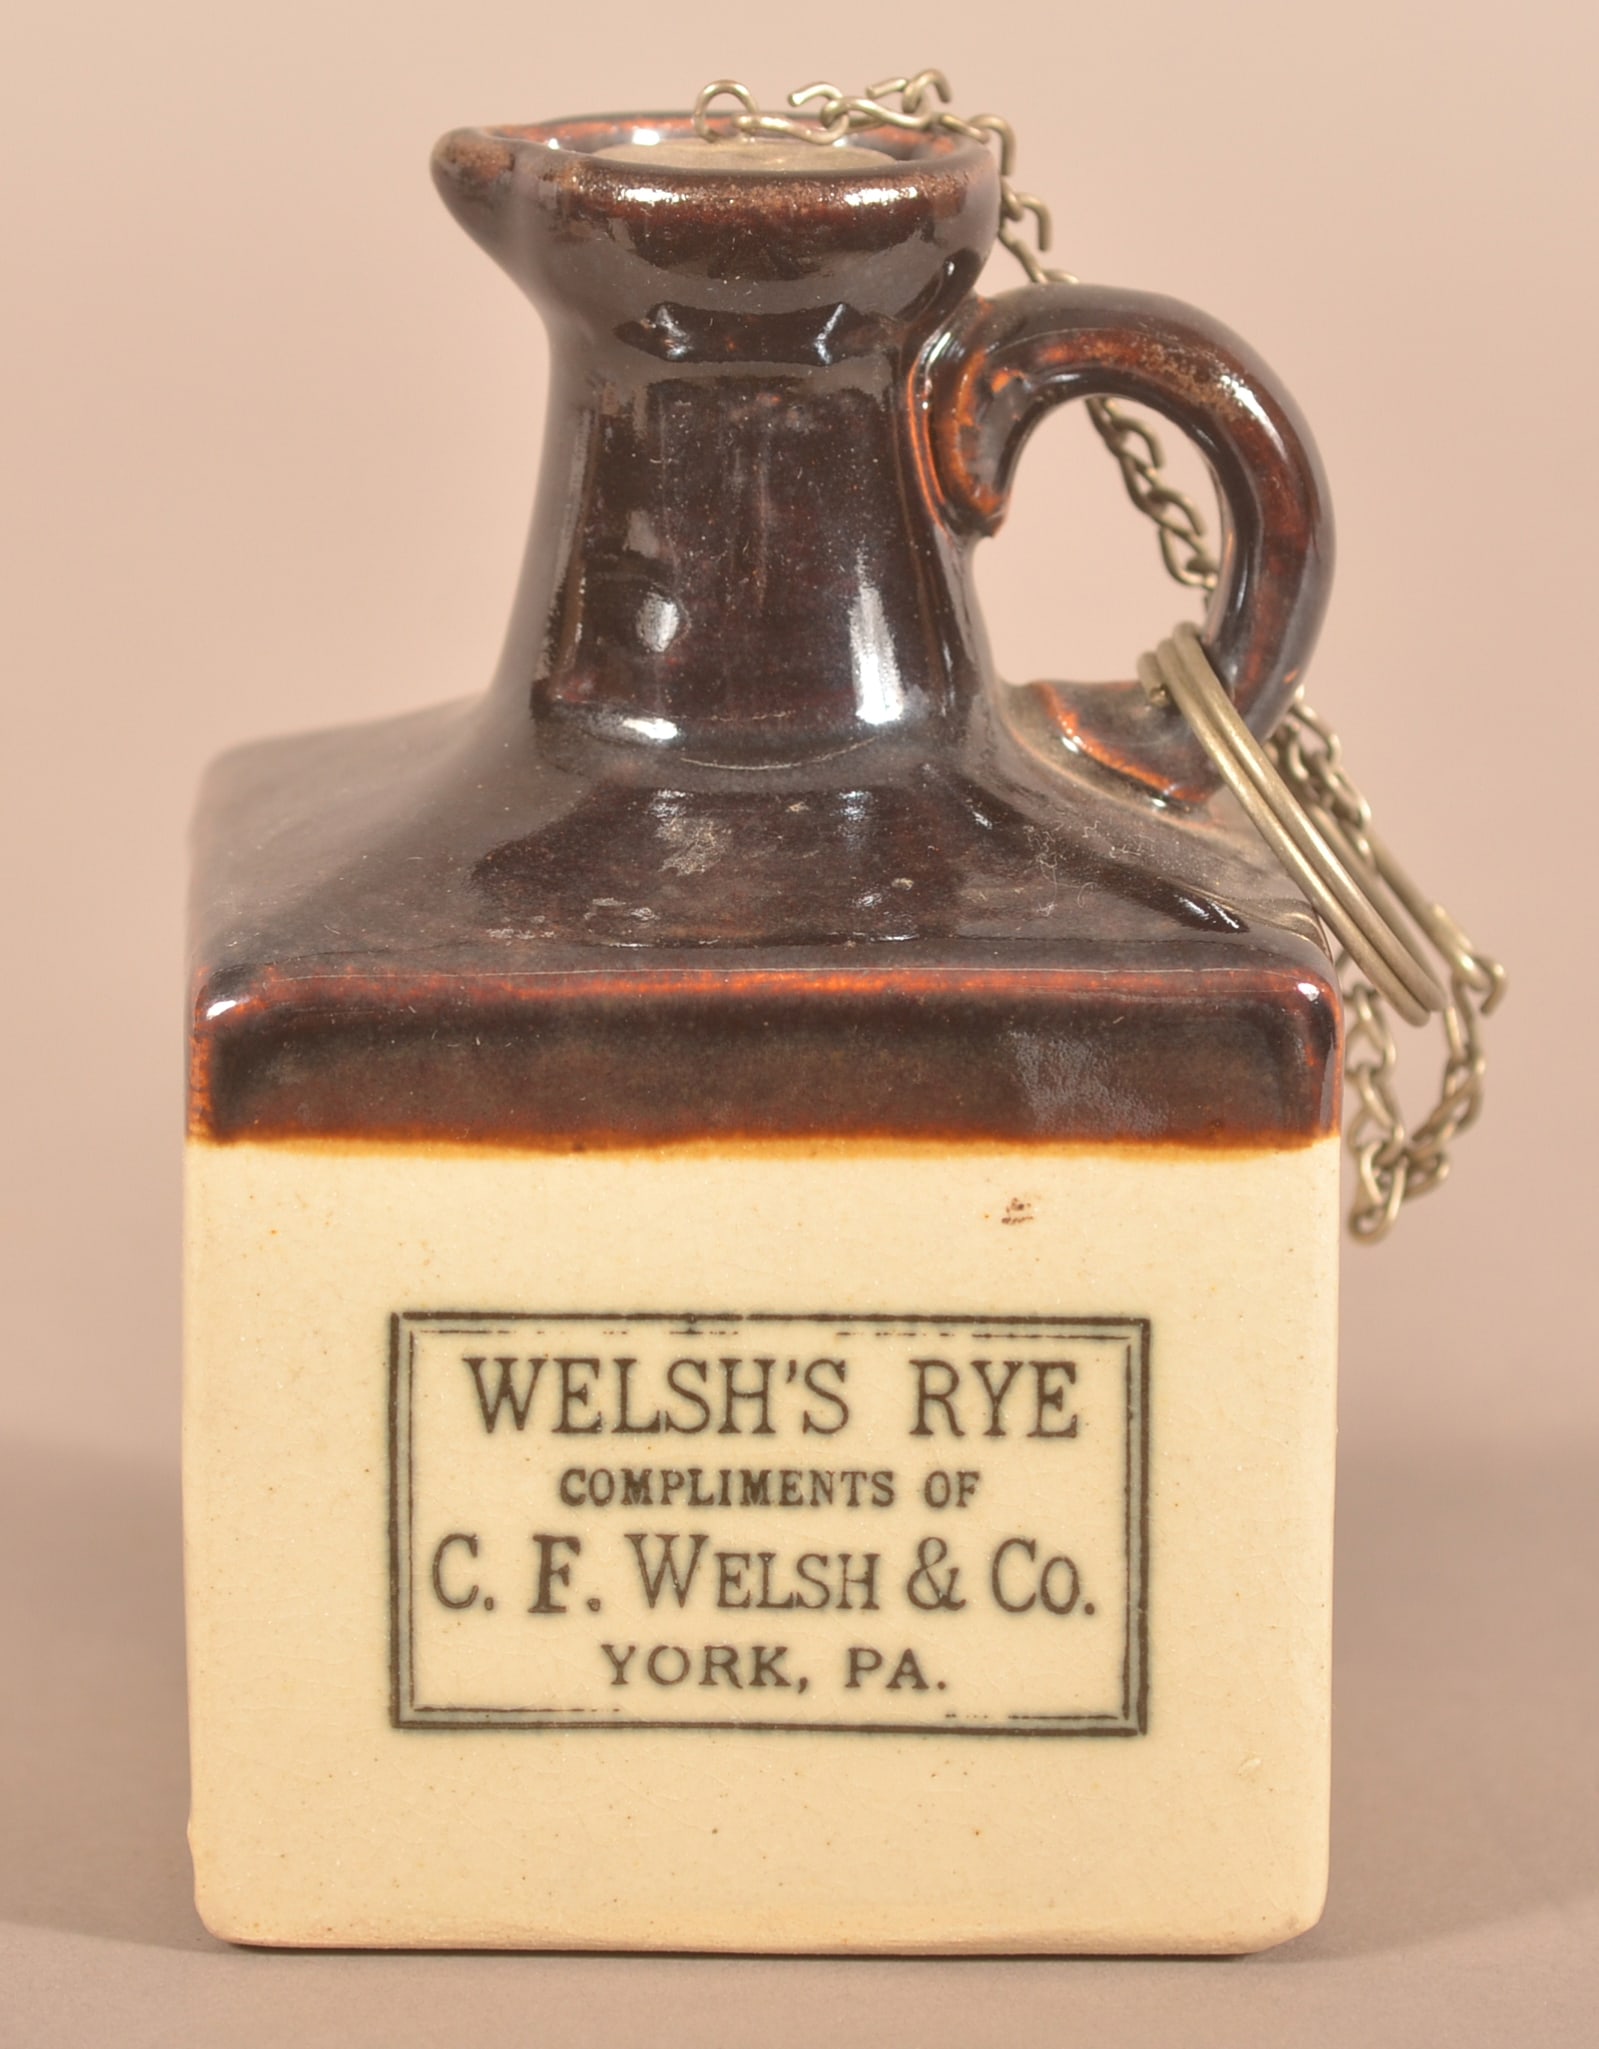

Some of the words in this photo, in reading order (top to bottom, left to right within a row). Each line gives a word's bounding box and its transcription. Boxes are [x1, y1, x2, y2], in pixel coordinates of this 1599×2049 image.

[460, 1356, 850, 1437] WELSH'S
[908, 1357, 1079, 1440] RYE
[558, 1466, 896, 1509] COMPLIMENTS
[922, 1469, 981, 1511] OF
[430, 1532, 496, 1613] C.
[526, 1532, 602, 1616] F.
[905, 1535, 968, 1613] &
[599, 1642, 810, 1695] YORK,
[843, 1646, 947, 1692] PA.
